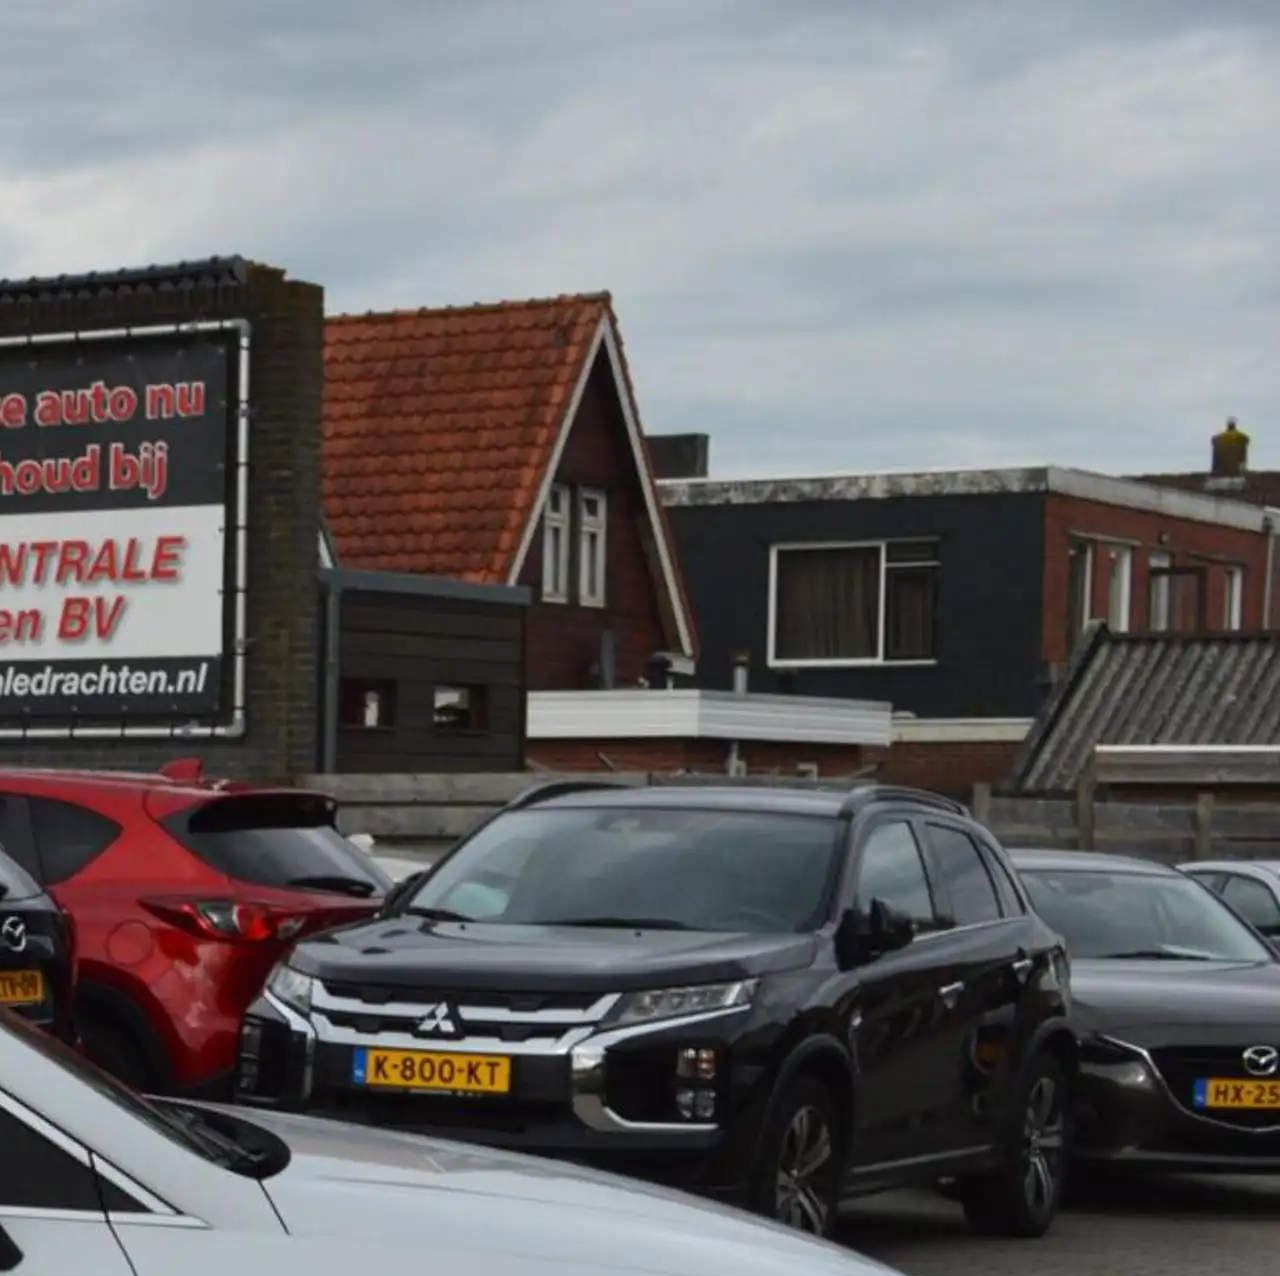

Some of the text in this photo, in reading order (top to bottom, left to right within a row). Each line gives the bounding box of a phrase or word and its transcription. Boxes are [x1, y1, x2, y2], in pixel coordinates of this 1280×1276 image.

[34, 381, 137, 426] auto
[145, 380, 204, 420] nu
[109, 440, 168, 500] bij
[57, 595, 126, 643] BV
[374, 1055, 501, 1087] K-800-KT
